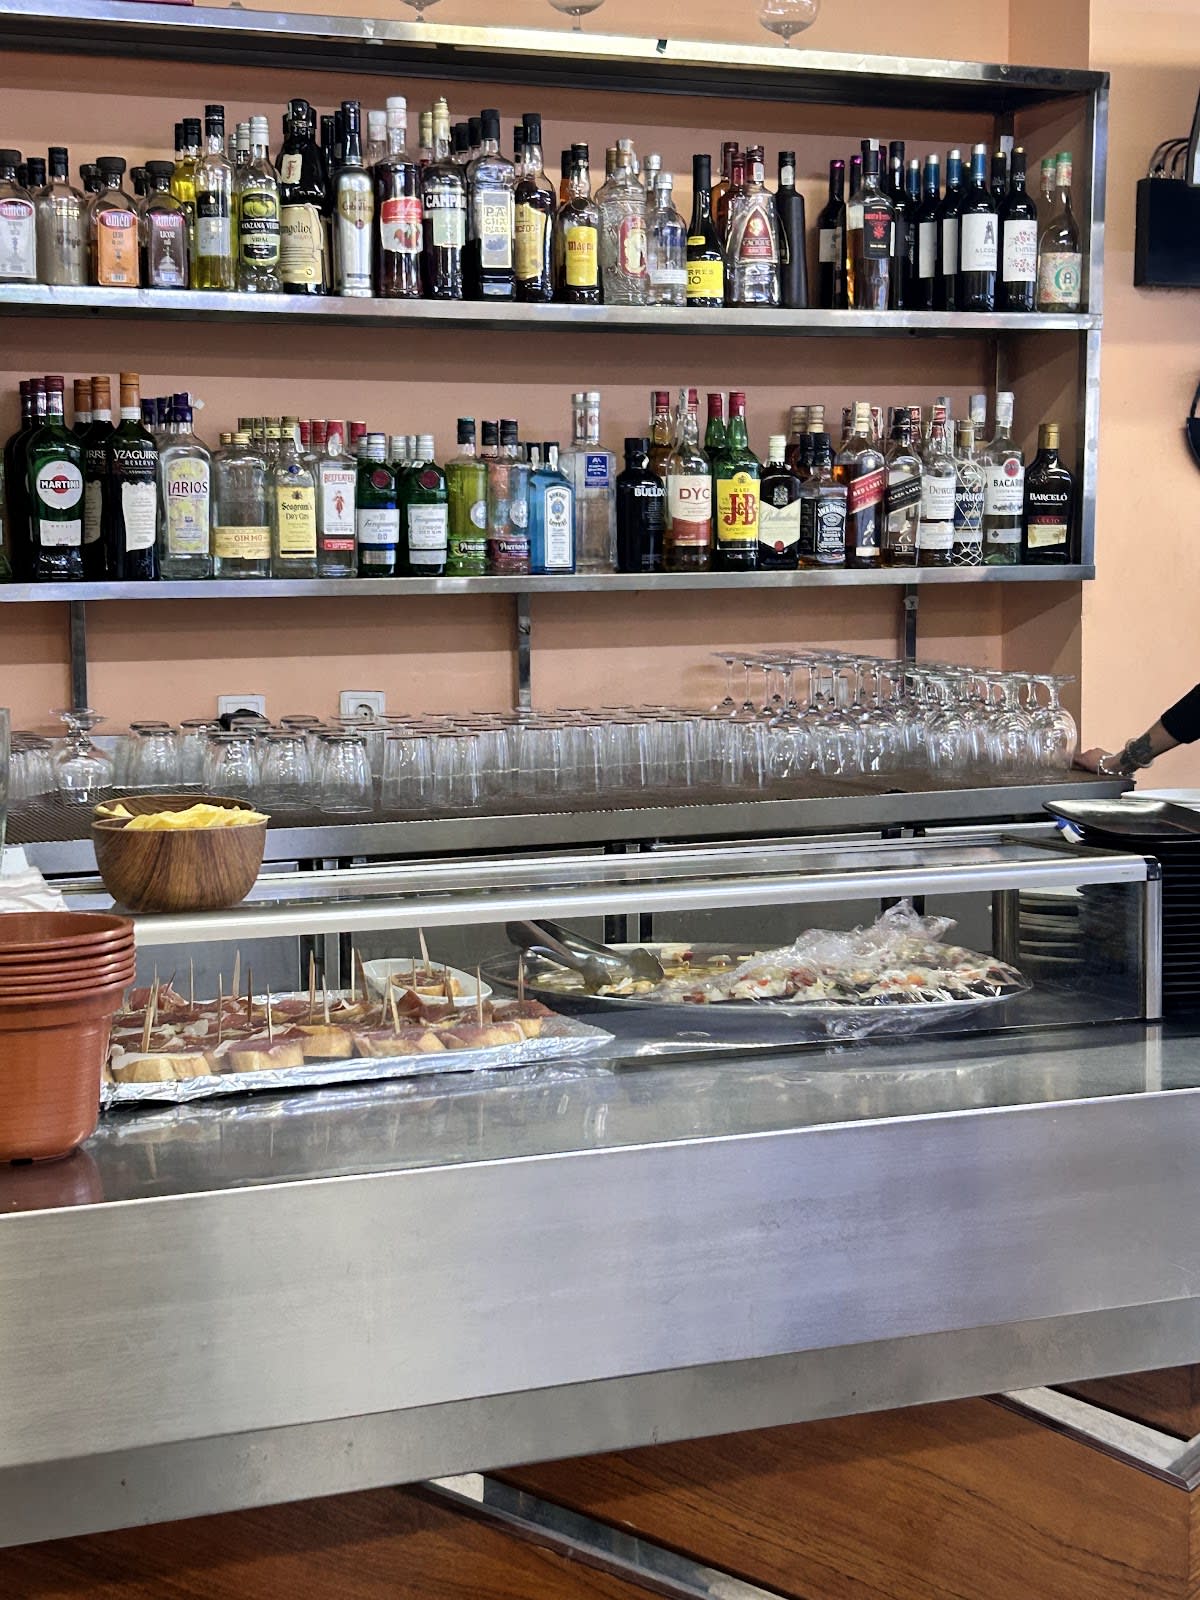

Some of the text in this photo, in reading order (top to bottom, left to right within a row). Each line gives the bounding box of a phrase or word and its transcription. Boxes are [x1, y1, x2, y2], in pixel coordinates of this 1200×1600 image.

[41, 479, 80, 489] MARTINI
[168, 480, 208, 498] LARIOS
[679, 488, 710, 500] DYC
[1029, 490, 1068, 502] BARCELÓ
